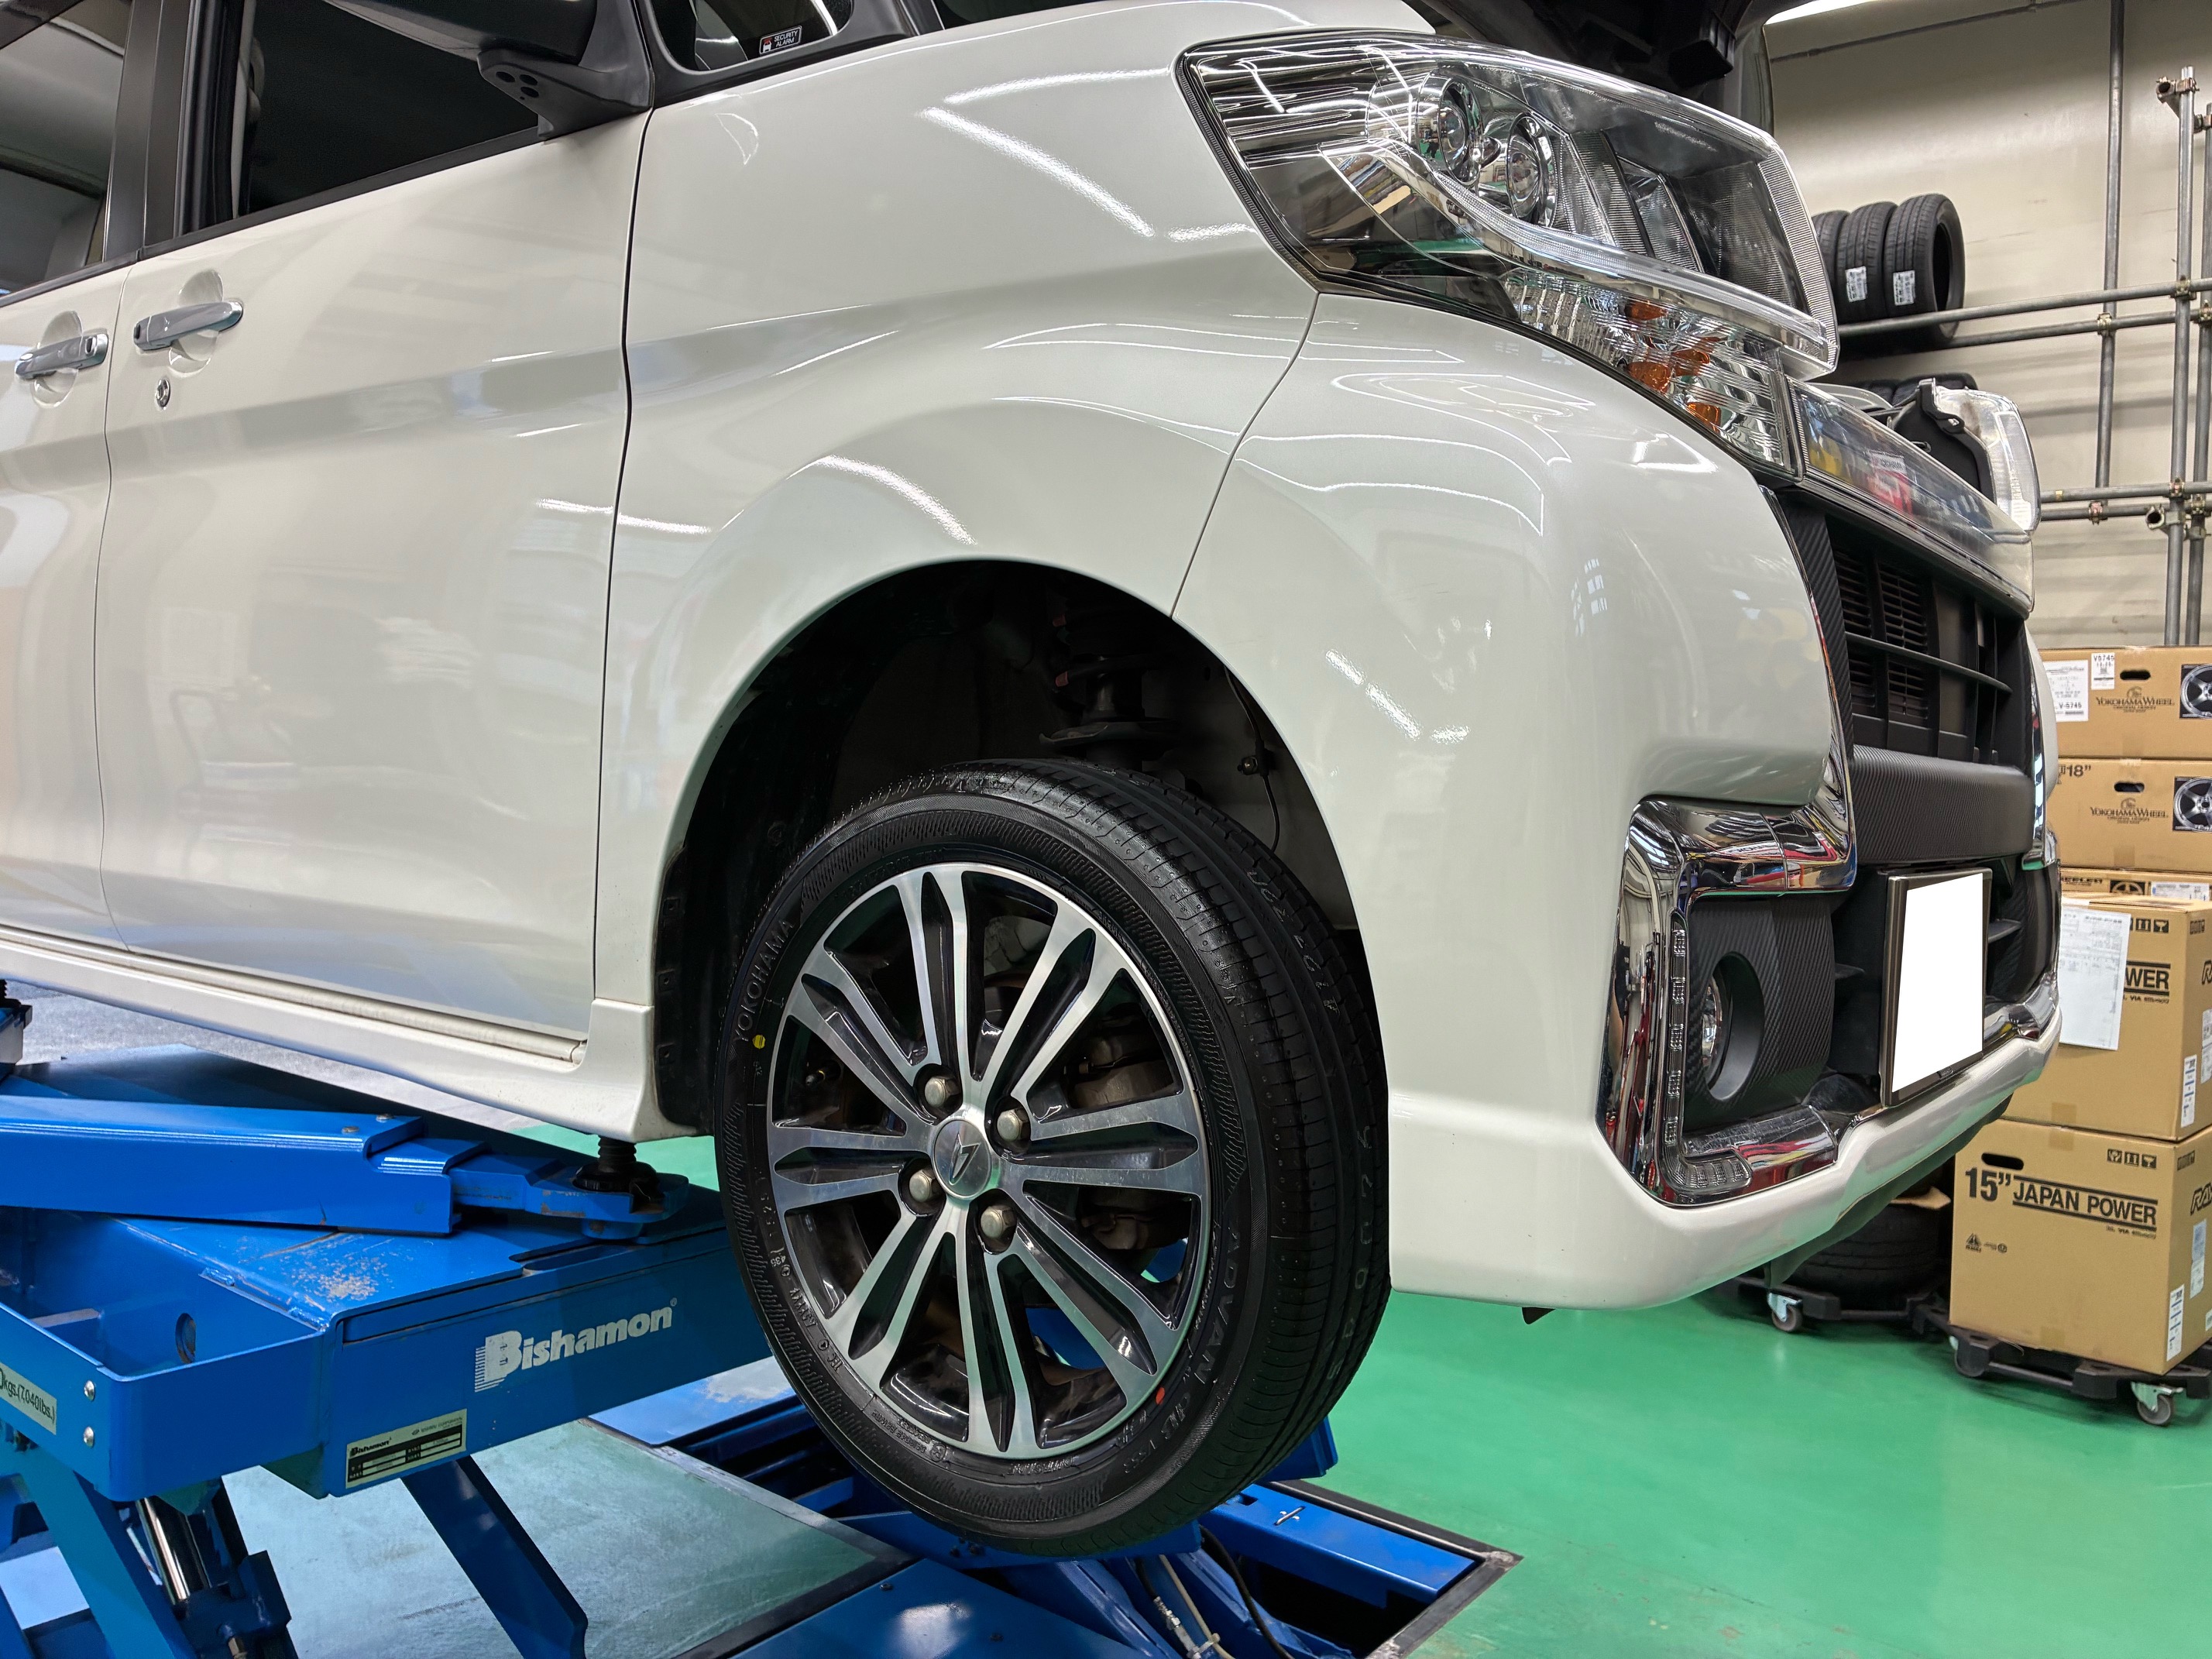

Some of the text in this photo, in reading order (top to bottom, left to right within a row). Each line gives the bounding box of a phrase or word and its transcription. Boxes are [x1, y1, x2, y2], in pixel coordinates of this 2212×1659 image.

[775, 30, 798, 42] SECURITY
[776, 37, 795, 47] ALARM
[733, 919, 795, 1042] YOKOHAMA
[2124, 967, 2170, 990] WER
[2013, 1182, 2080, 1211] JAPAN
[2087, 1195, 2157, 1225] POWER
[1194, 1221, 1242, 1385] ADVAN
